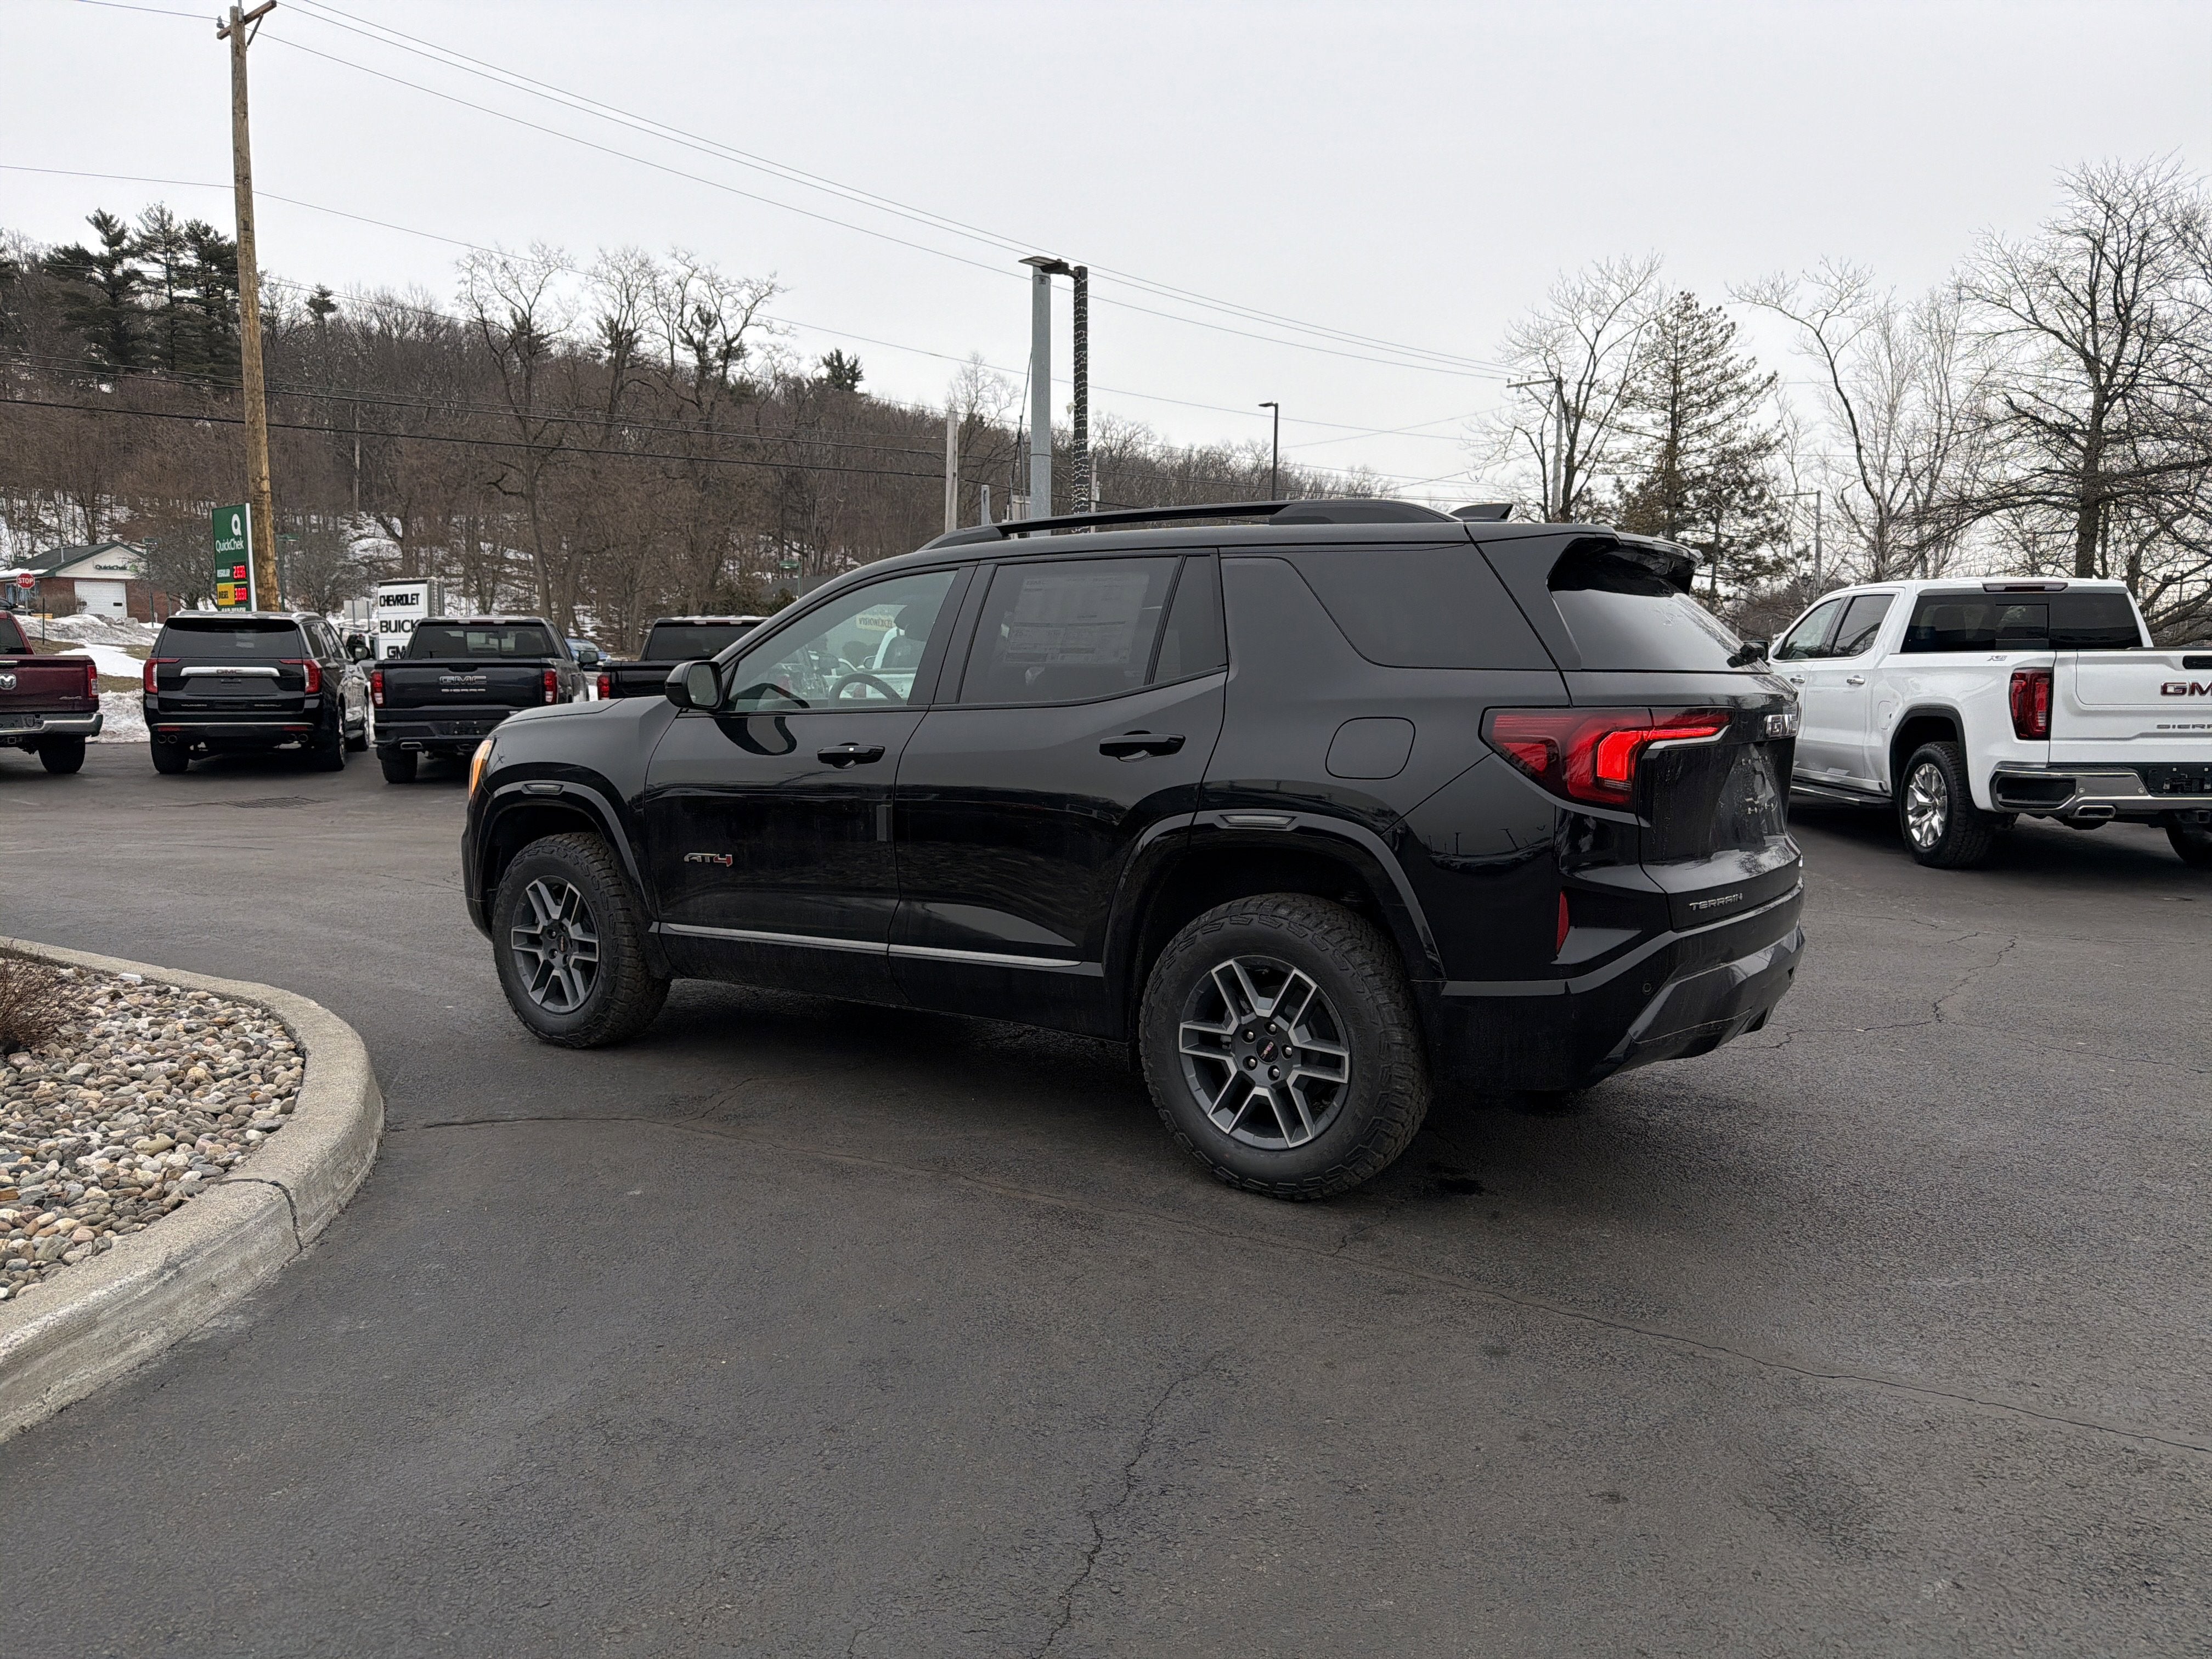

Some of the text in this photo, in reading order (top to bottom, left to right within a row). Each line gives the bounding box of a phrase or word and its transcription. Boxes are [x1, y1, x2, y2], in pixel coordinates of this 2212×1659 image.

[216, 537, 245, 554] QuickChek
[379, 593, 420, 607] CHEVROLET
[380, 619, 420, 633] BUICK
[387, 646, 407, 659] GM
[439, 675, 487, 685] GMC
[2160, 681, 2212, 696] GM
[1766, 714, 1797, 737] GMC
[684, 853, 733, 867] AT4
[1689, 893, 1743, 911] TERRAIN
